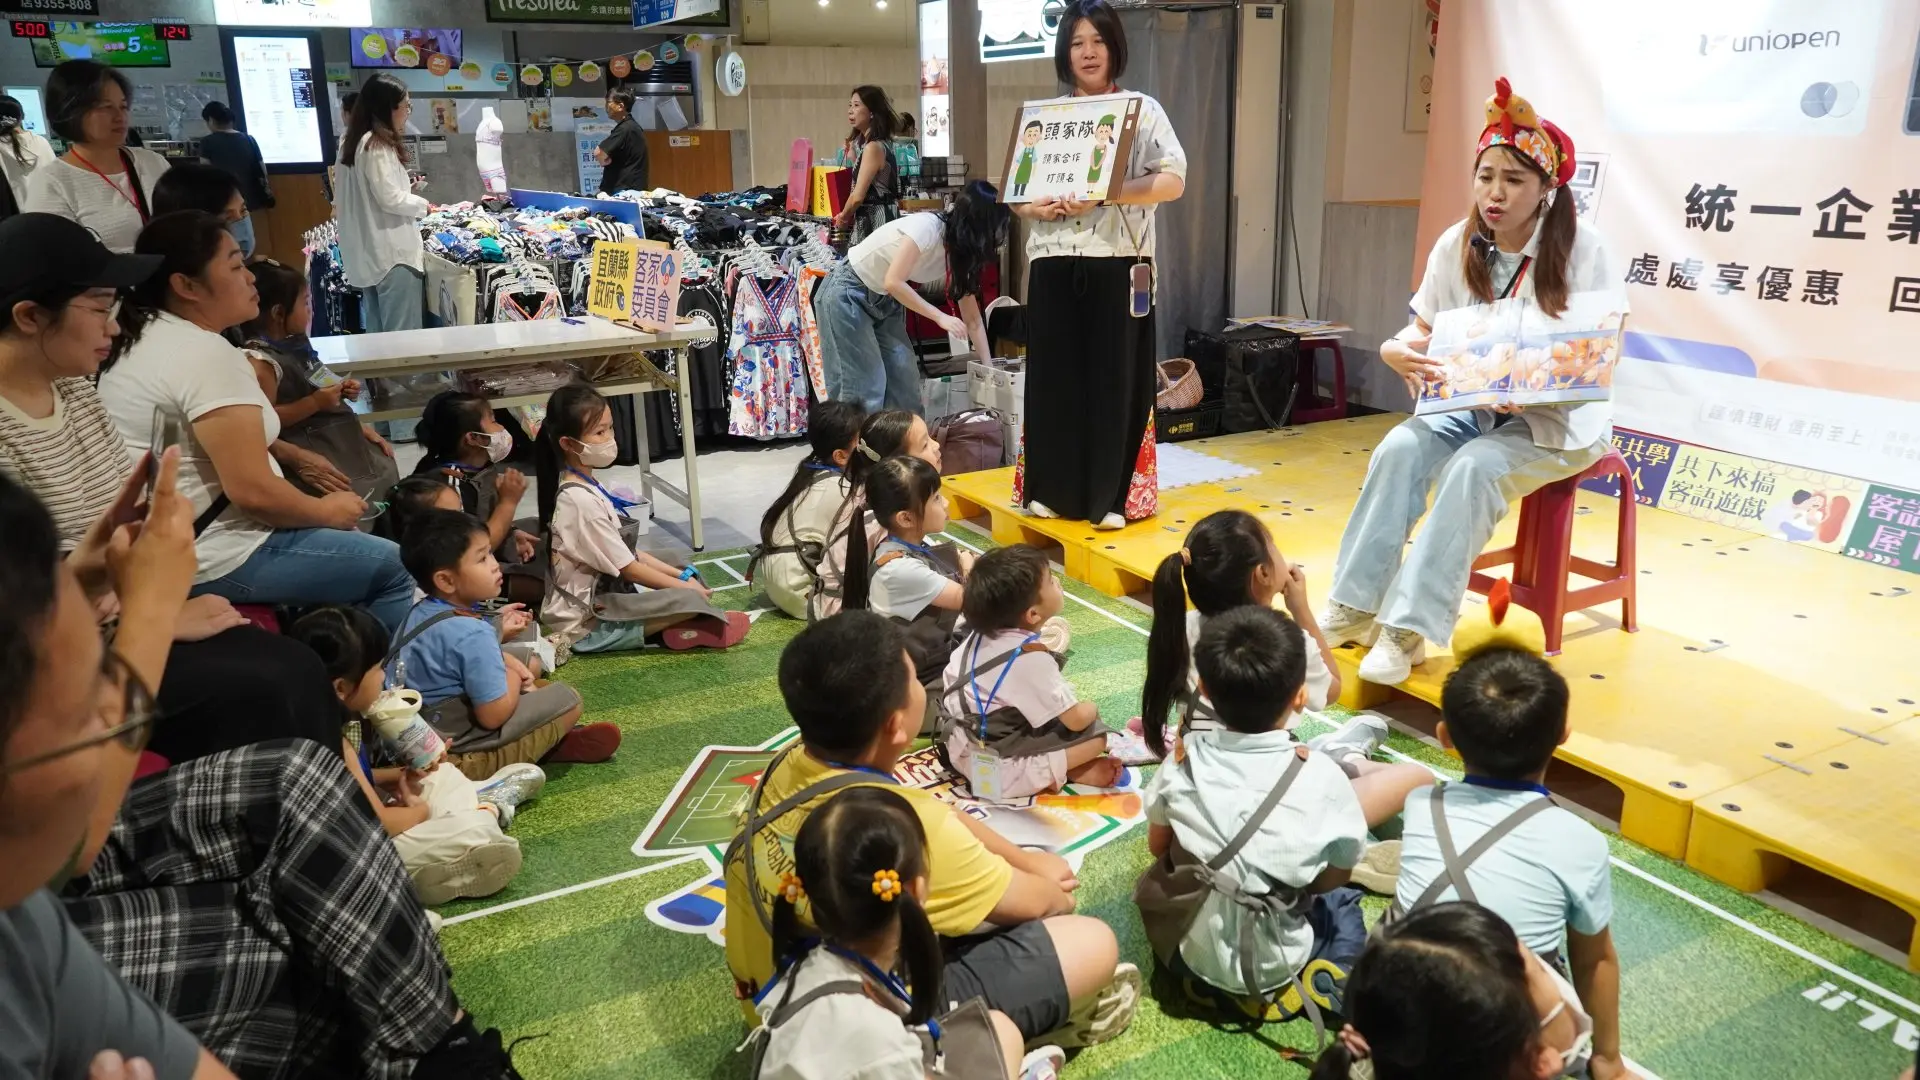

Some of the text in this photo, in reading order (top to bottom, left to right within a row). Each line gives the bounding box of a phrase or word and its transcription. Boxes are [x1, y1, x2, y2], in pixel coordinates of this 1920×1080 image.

[15, 23, 46, 36] 500
[162, 26, 187, 39] 124
[1731, 29, 1841, 53] uniopen
[127, 36, 141, 53] 5
[1044, 120, 1095, 140] 頭家隊
[1043, 152, 1082, 164] 頭家合作
[1046, 173, 1075, 183] 打頭名
[1684, 183, 1920, 244] 統一企業
[597, 249, 629, 280] 宜蘭縣
[635, 250, 662, 285] 客家
[1624, 252, 1843, 306] 處處享優惠
[594, 279, 616, 309] 政府
[632, 285, 671, 324] 委員會
[1788, 419, 1864, 446] 信用至上
[1676, 455, 1778, 496] 共下來搞
[1669, 480, 1768, 520] 客語遊戲
